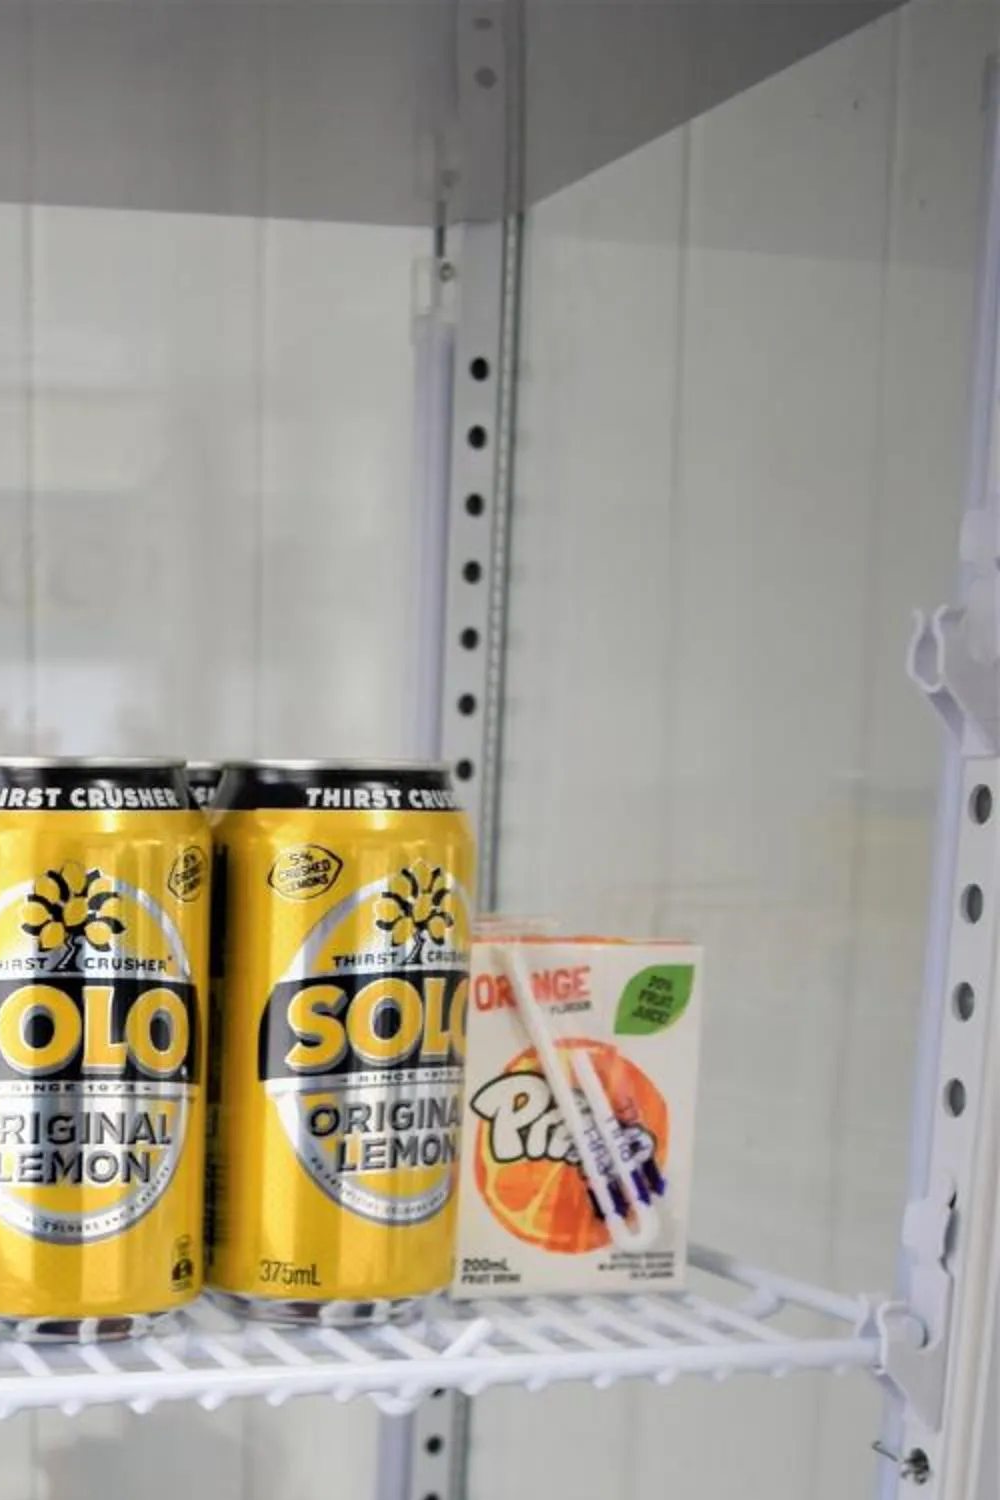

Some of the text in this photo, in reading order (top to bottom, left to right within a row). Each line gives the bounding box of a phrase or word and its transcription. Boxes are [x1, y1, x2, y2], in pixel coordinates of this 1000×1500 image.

[70, 787, 180, 808] CRUSHER
[305, 787, 402, 809] THIRST
[83, 956, 168, 971] CRUSHER
[333, 952, 398, 969] THIRST
[474, 965, 592, 1012] ORNGE
[9, 1082, 80, 1093] SINCE
[308, 1097, 461, 1138] ORIGINA
[337, 1133, 459, 1173] LEMON
[259, 1259, 322, 1287] 375mL
